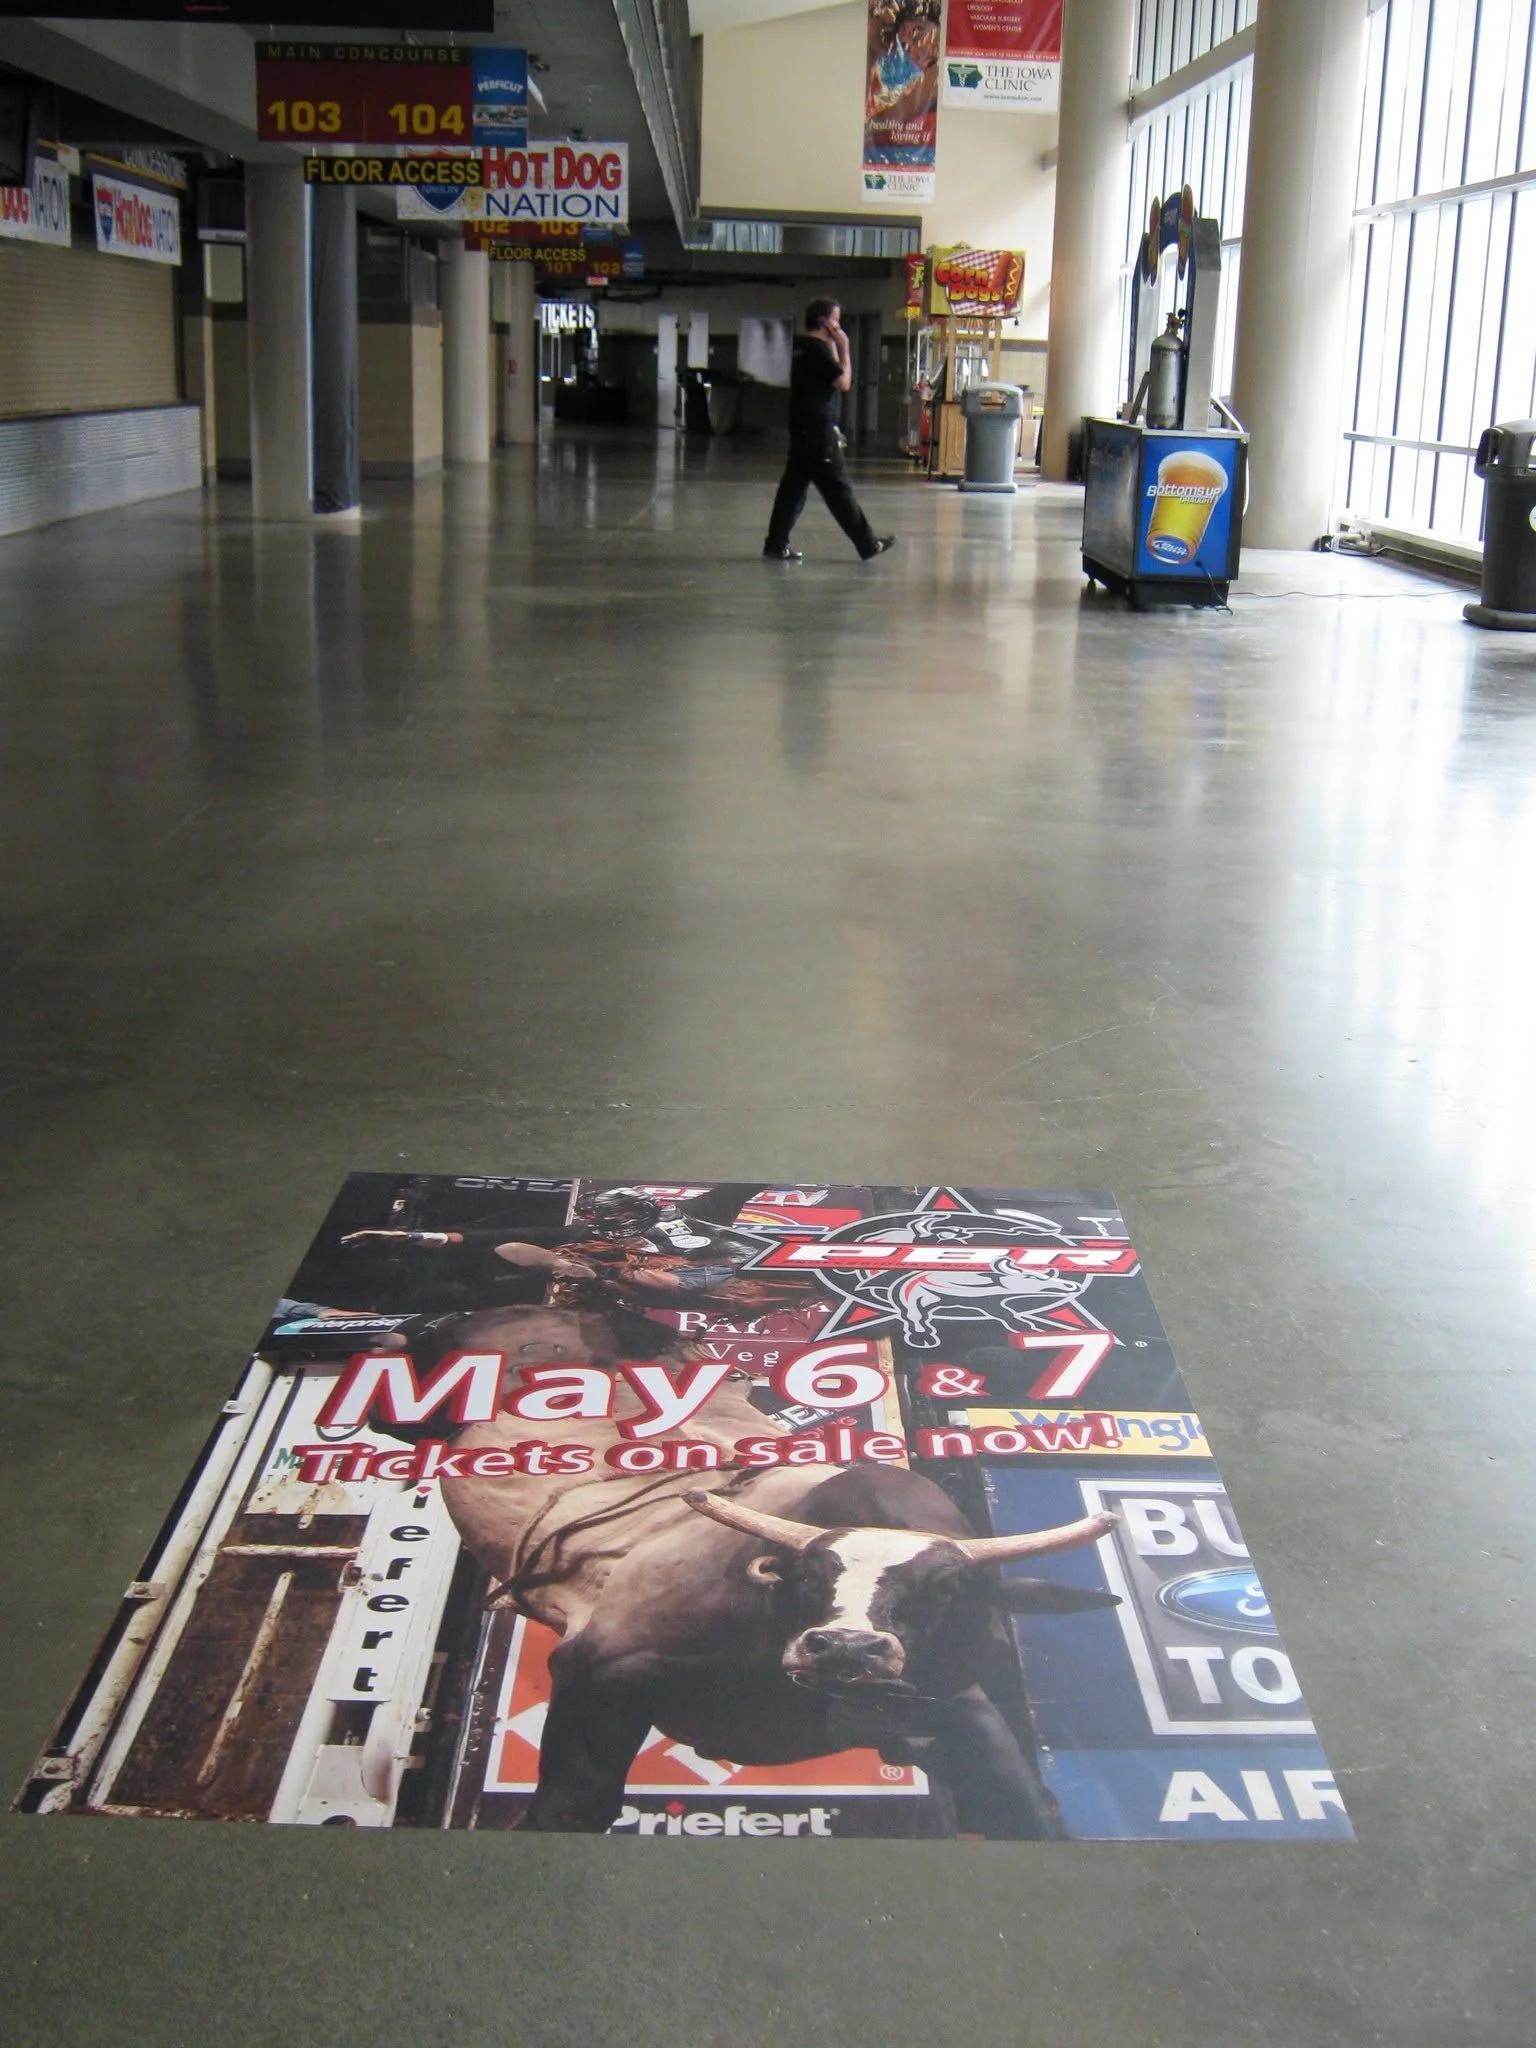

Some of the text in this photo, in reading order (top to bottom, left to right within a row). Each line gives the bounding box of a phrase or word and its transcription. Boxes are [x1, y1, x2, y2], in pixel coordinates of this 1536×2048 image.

[267, 45, 461, 63] MAIN CONCOURSE
[985, 65, 1053, 80] THE IOWA
[984, 79, 1034, 92] CLINIC
[267, 101, 342, 133] 103
[388, 103, 465, 135] 104
[869, 118, 924, 131] healthy and
[890, 131, 931, 144] loving it
[306, 159, 480, 184] FLOOR ACCESS
[482, 145, 622, 191] HOT DOG
[485, 193, 619, 219] NATION
[471, 219, 511, 234] 102
[538, 220, 580, 235] 103
[489, 247, 587, 262] FLOOR ACCESS
[544, 262, 574, 274] 101
[592, 262, 621, 275] 102
[540, 303, 596, 329] TICKETS
[1146, 483, 1205, 497] Bottoms
[786, 1245, 1127, 1267] PBR
[315, 1350, 732, 1439] May
[771, 1339, 889, 1409] 6
[922, 1364, 989, 1398] &
[1015, 1329, 1115, 1400] 7
[294, 1439, 595, 1483] Tickets
[604, 1440, 725, 1474] on
[735, 1424, 907, 1469] sale
[922, 1412, 1122, 1459] now!
